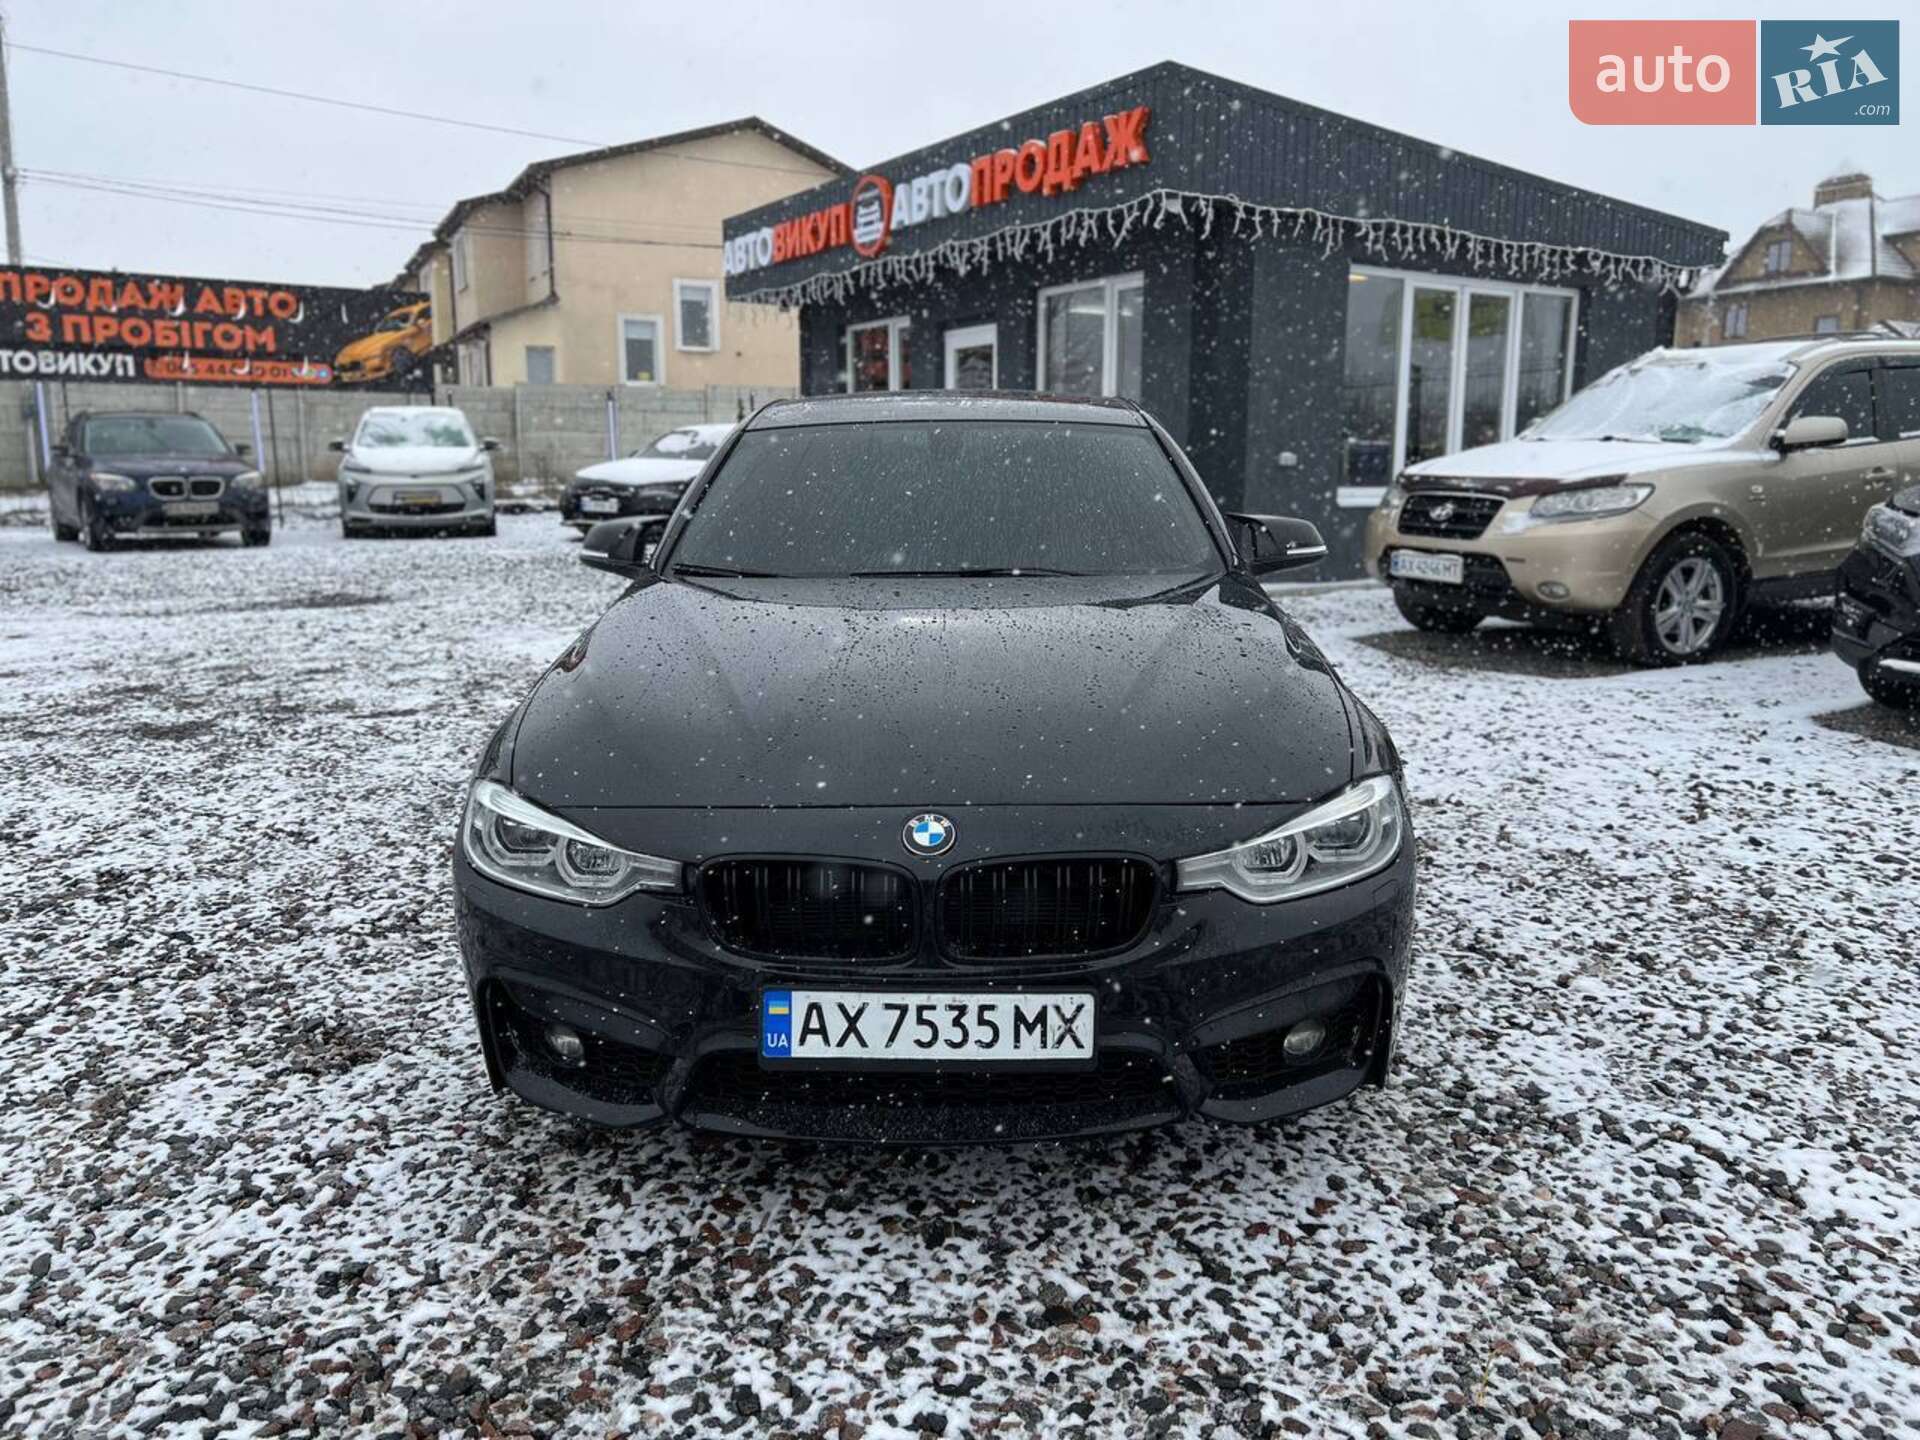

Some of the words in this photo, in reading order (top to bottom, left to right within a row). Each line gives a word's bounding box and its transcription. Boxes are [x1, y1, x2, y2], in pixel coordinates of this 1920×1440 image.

[724, 203, 851, 275] АВТОВИКУП
[890, 106, 1150, 231] АВТОПРОДАЖ
[0, 271, 186, 312] ПРОДАЖ
[193, 285, 298, 318] АВТО
[62, 314, 276, 352] ПРОБІГОМ
[767, 1032, 788, 1048] UA
[798, 1002, 869, 1048] AX
[883, 1003, 1000, 1049] 7535
[1013, 1003, 1086, 1049] MX
